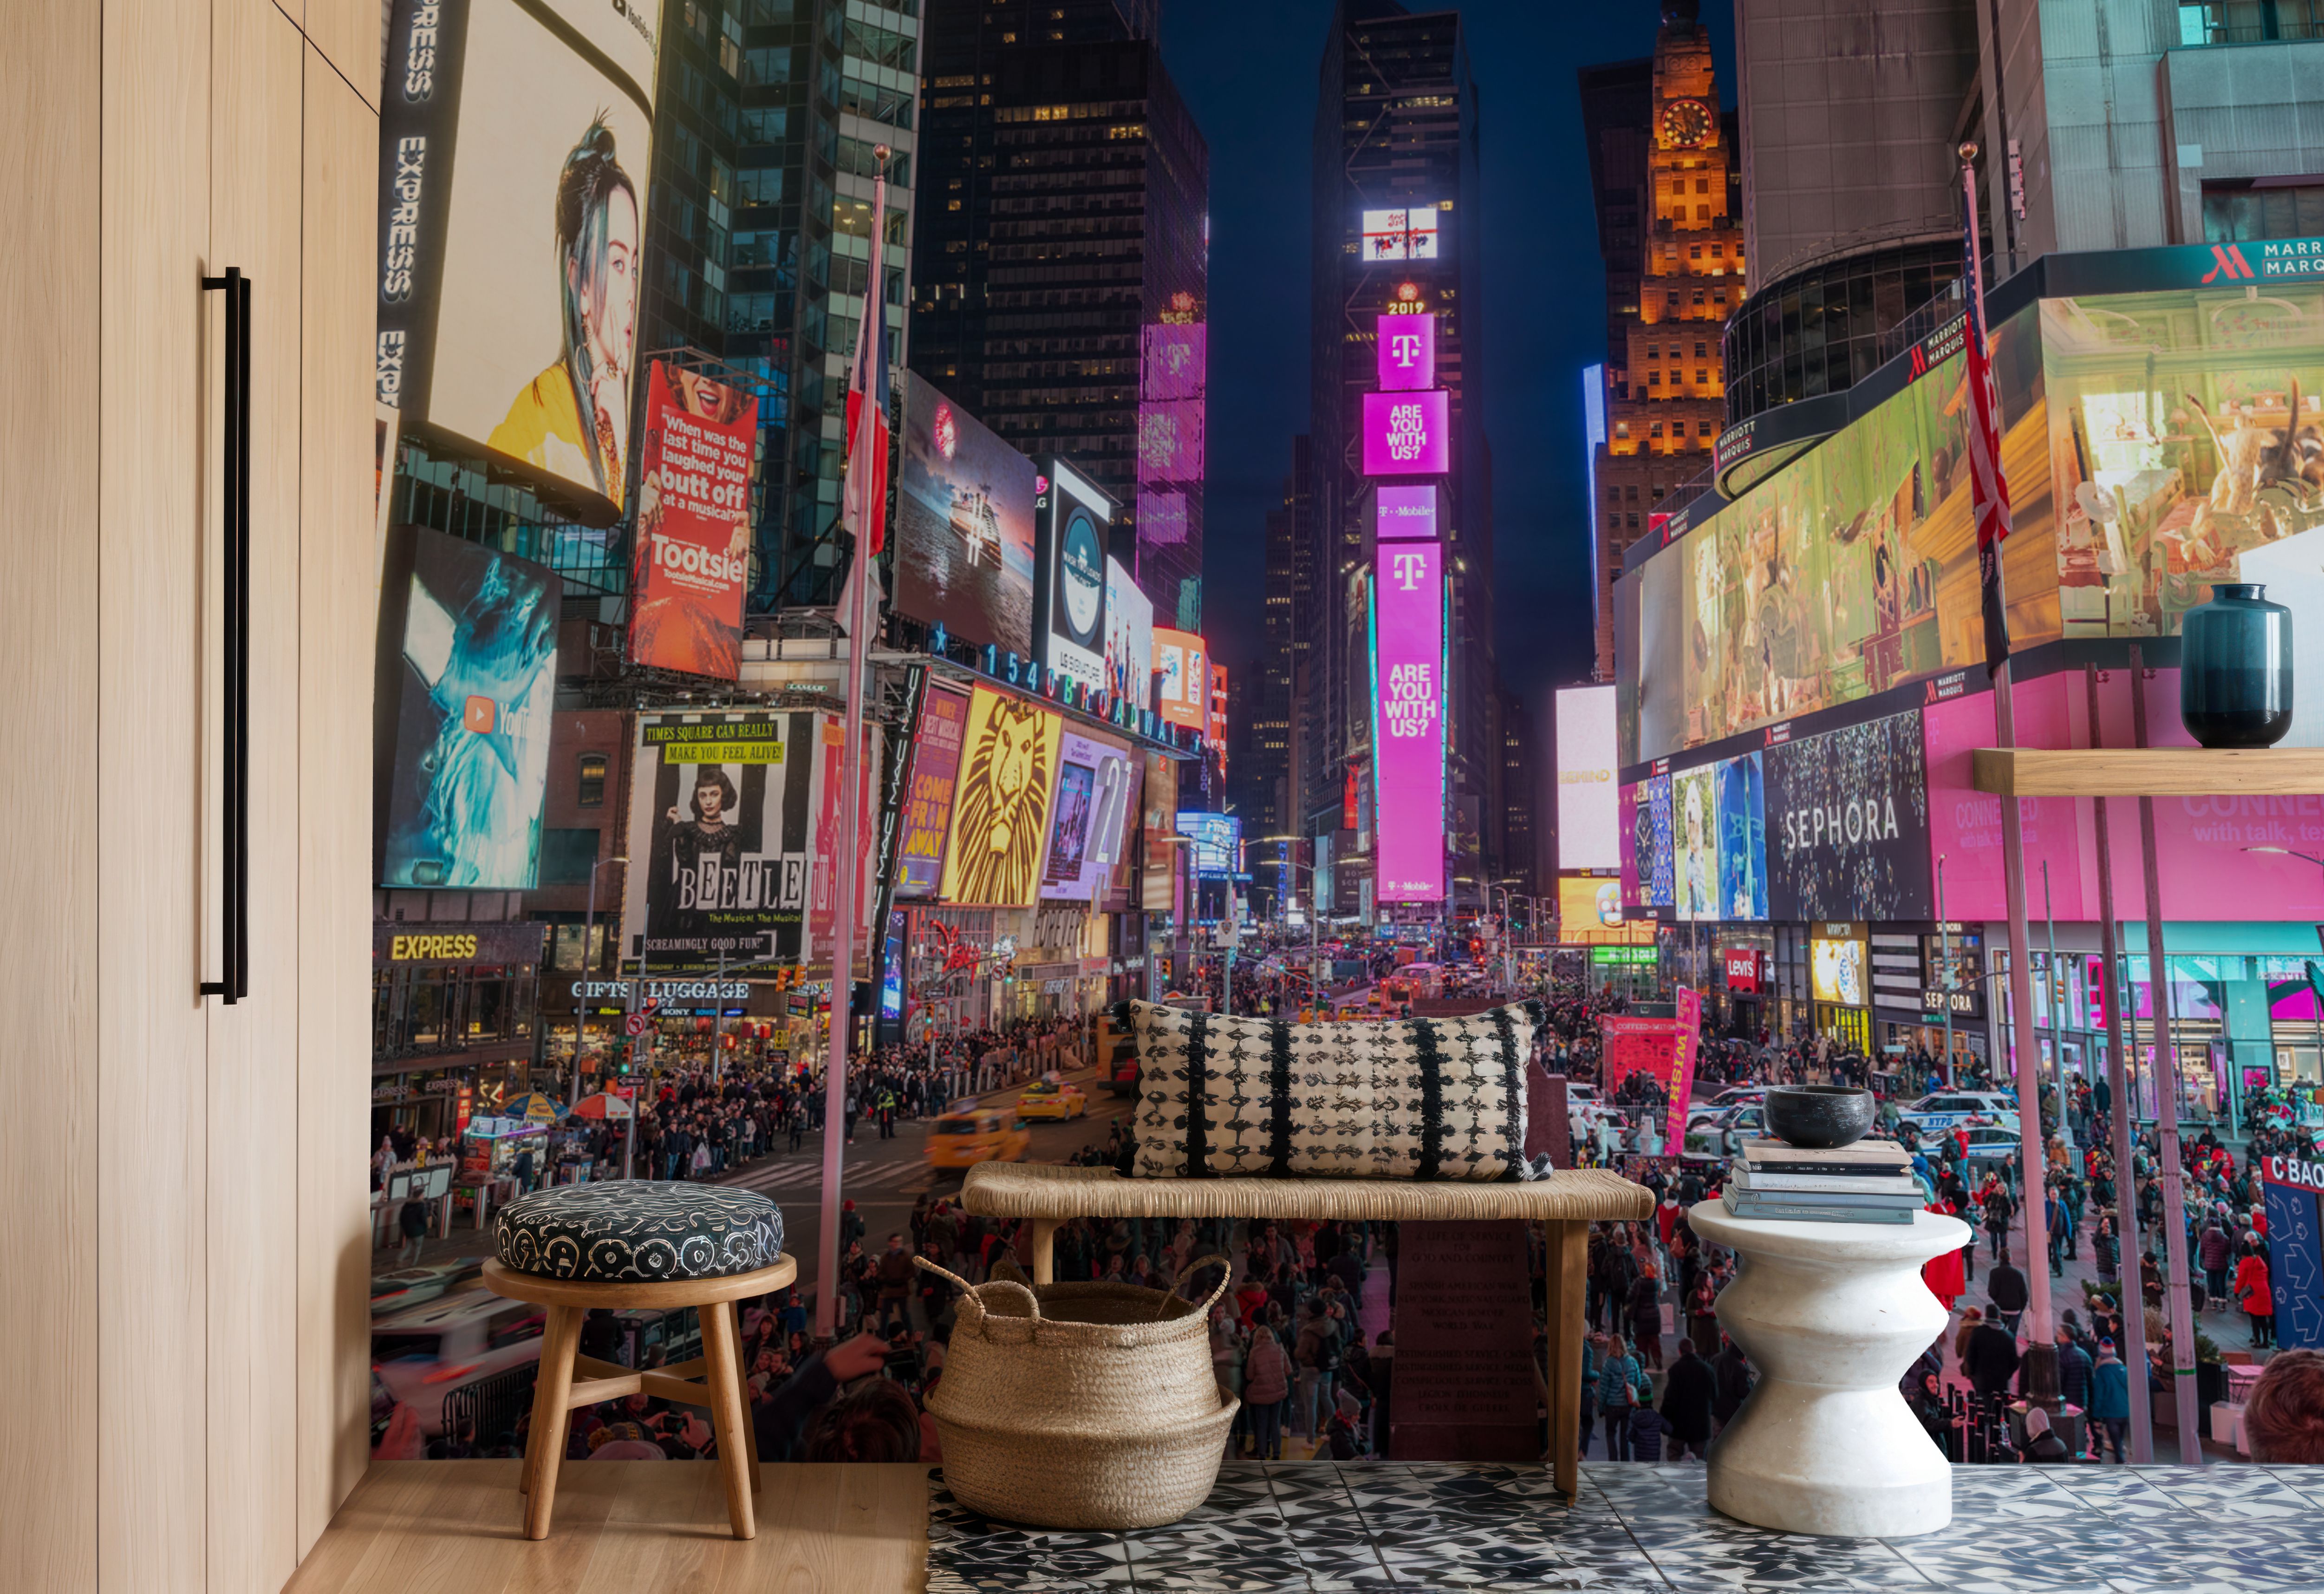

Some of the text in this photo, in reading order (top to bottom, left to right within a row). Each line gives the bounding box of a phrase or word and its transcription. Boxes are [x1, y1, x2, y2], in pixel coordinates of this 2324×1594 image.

[383, 137, 426, 302] EXPRESS
[1388, 302, 1425, 315] 2019
[1927, 314, 1966, 350] MARRIOTT
[1929, 333, 1964, 365] MARQUIS
[1390, 405, 1422, 418] ARE
[1390, 418, 1423, 433] YOU
[664, 428, 746, 469] last time you
[703, 429, 726, 446] was
[728, 436, 747, 453] the
[1386, 431, 1426, 447] WITH
[1391, 444, 1421, 460] US?
[662, 446, 745, 484] laughed your
[661, 463, 744, 509] butt off
[663, 494, 676, 506] at
[677, 498, 685, 509] a
[651, 532, 743, 583] Tootsie
[1390, 664, 1431, 682] ARE
[987, 643, 1056, 697] 1540
[1063, 674, 1178, 746] BROADWAY
[1389, 682, 1431, 700] YOU
[1384, 700, 1436, 718] WITH
[646, 723, 774, 742] TIMES SQUARE CAN REALLY
[1391, 719, 1429, 737] US?
[669, 745, 781, 760] MAKE YOU FEEL ALIVE!
[914, 773, 952, 804] COME
[1559, 770, 1610, 784] BEHIND
[909, 800, 949, 830] FROM
[1955, 796, 2038, 829] CONNEED
[2182, 795, 2324, 818] CONNE
[1785, 795, 1900, 850] SEPHORA
[2193, 821, 2241, 842] with
[2244, 820, 2294, 845] talk,
[904, 827, 945, 857] AWAY
[677, 852, 805, 910] BEETLE
[709, 914, 722, 923] The
[757, 913, 772, 923] The
[391, 934, 478, 961] EXPRESS
[711, 937, 736, 950] GOOD
[571, 981, 749, 999] GIFTS LUGGAGE
[1670, 1035, 1688, 1104] WISH
[1928, 1117, 1953, 1126] NYPD
